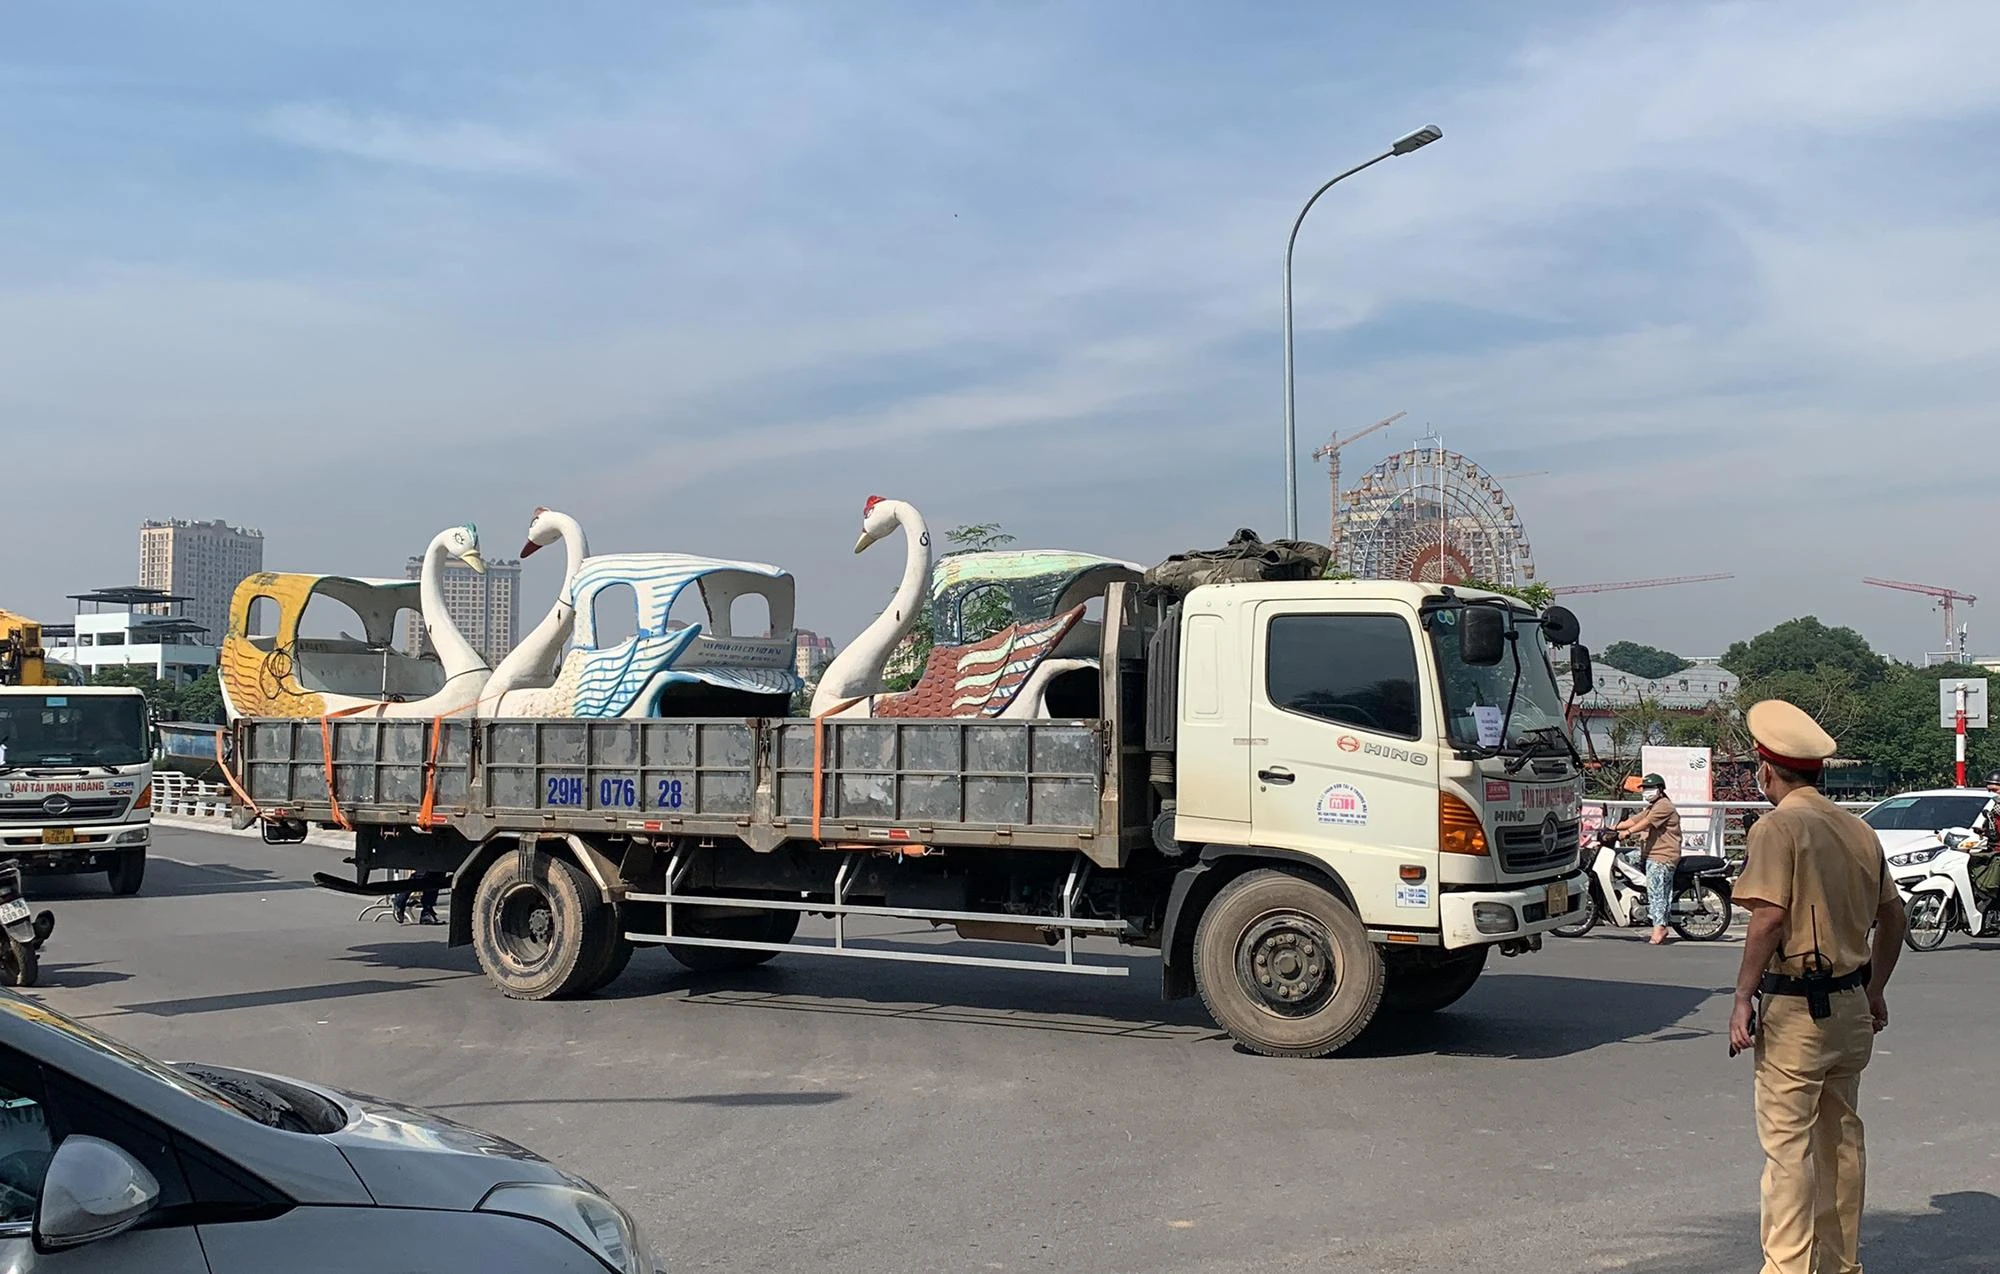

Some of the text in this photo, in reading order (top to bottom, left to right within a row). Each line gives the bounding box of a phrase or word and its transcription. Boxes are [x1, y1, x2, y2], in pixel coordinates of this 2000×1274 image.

[1364, 742, 1429, 766] HINO
[547, 777, 682, 808] 29H 076 28
[1494, 810, 1526, 822] HINO
